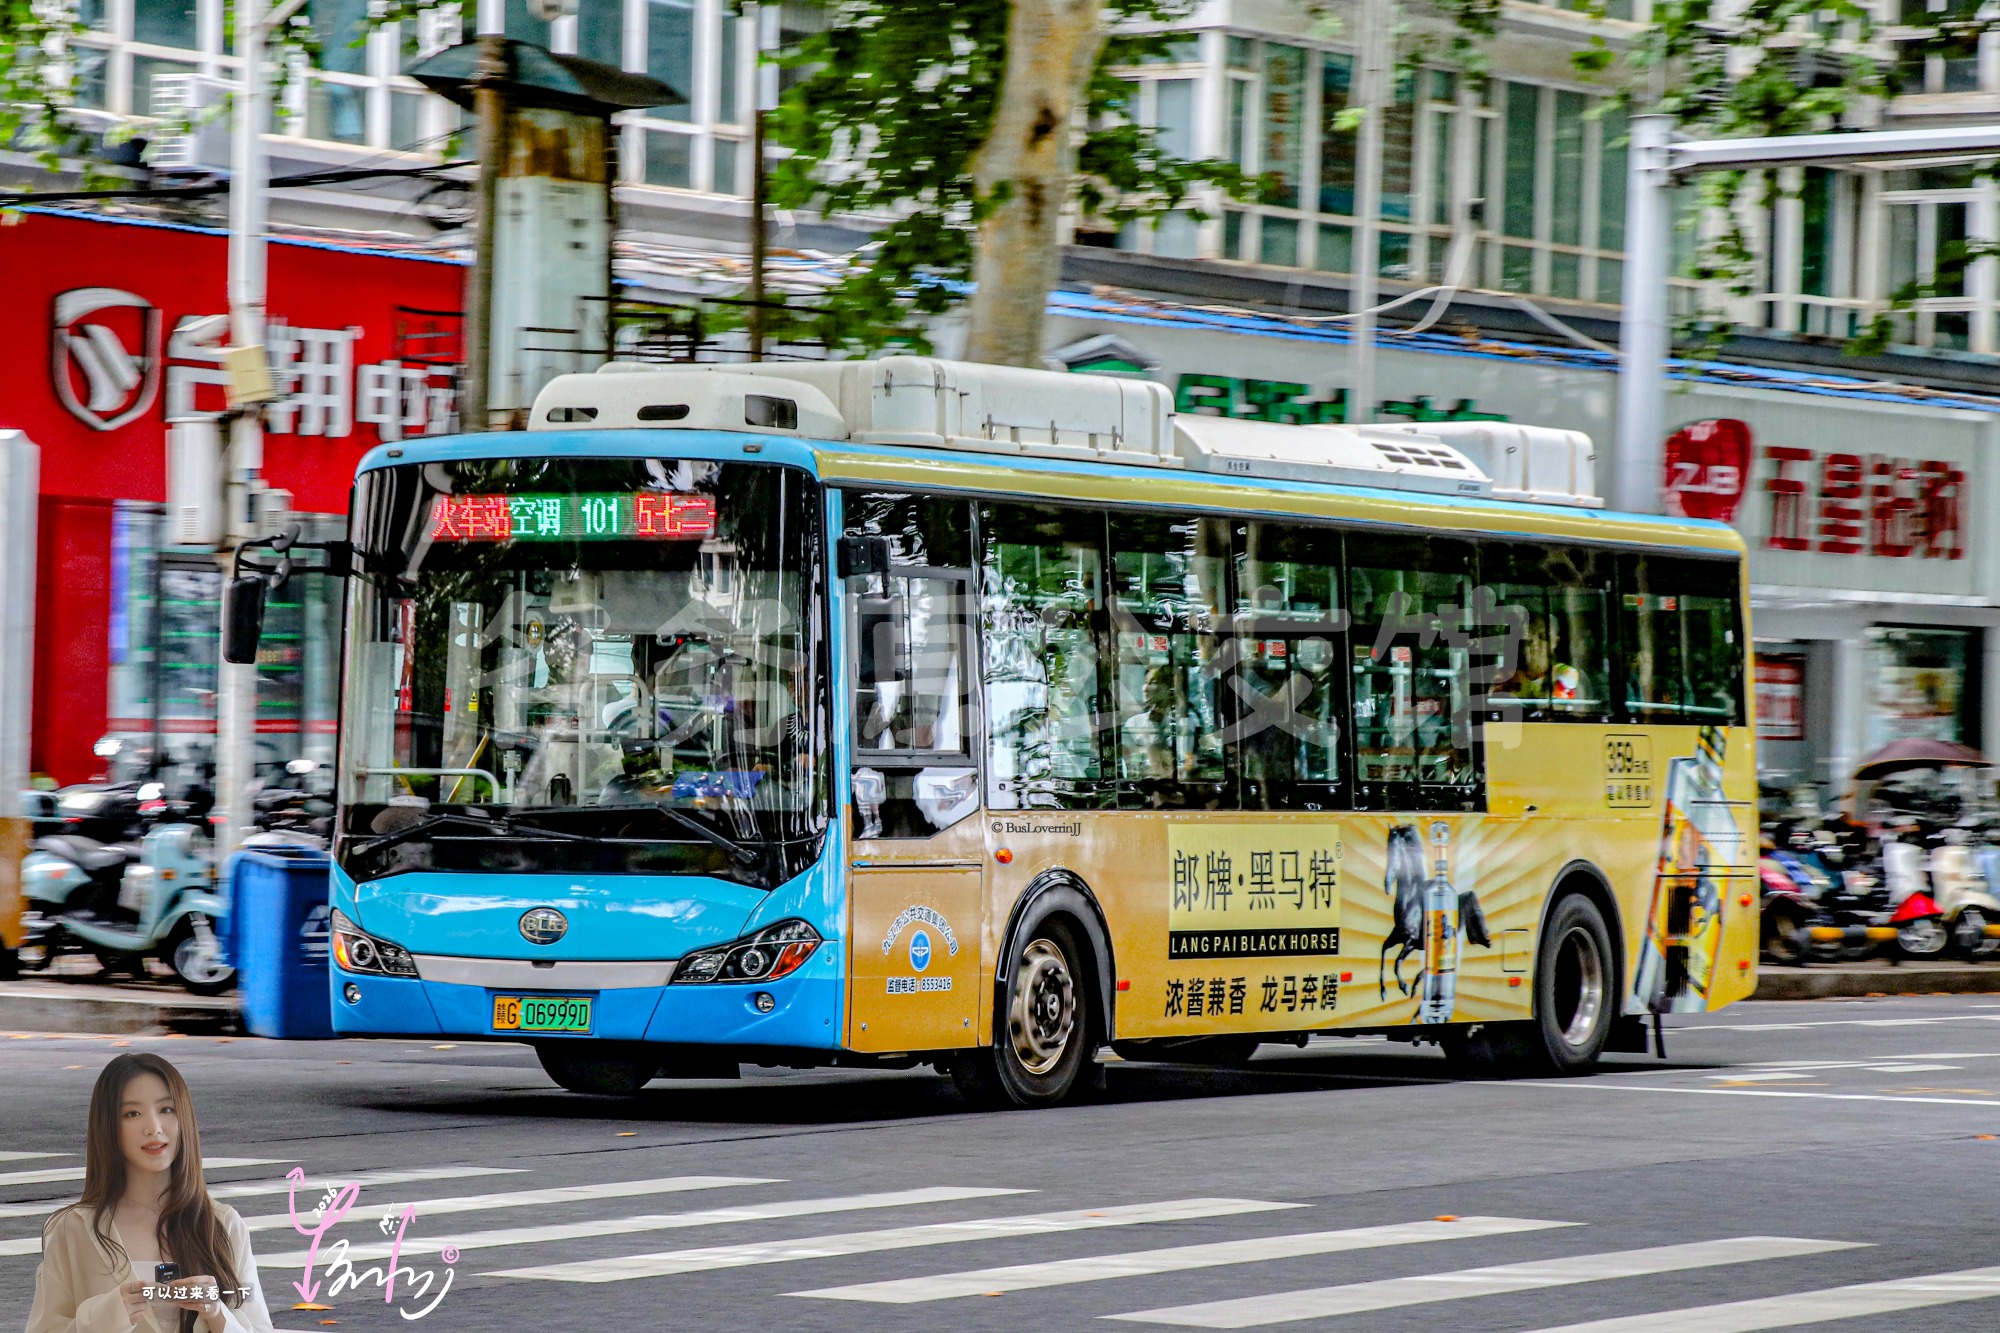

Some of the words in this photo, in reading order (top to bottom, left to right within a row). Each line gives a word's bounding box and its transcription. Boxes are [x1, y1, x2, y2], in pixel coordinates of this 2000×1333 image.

[431, 496, 510, 538] 火车站
[510, 497, 561, 536] 空调
[581, 498, 618, 533] 101
[636, 495, 716, 536] 五七二
[1172, 936, 1210, 953] LANG
[1213, 935, 1237, 952] PAI
[1241, 934, 1287, 952] BLACK
[1291, 932, 1338, 950] HORSE
[1165, 977, 1247, 1017] 浓酱兼香
[1261, 973, 1338, 1012] 龙马奔腾
